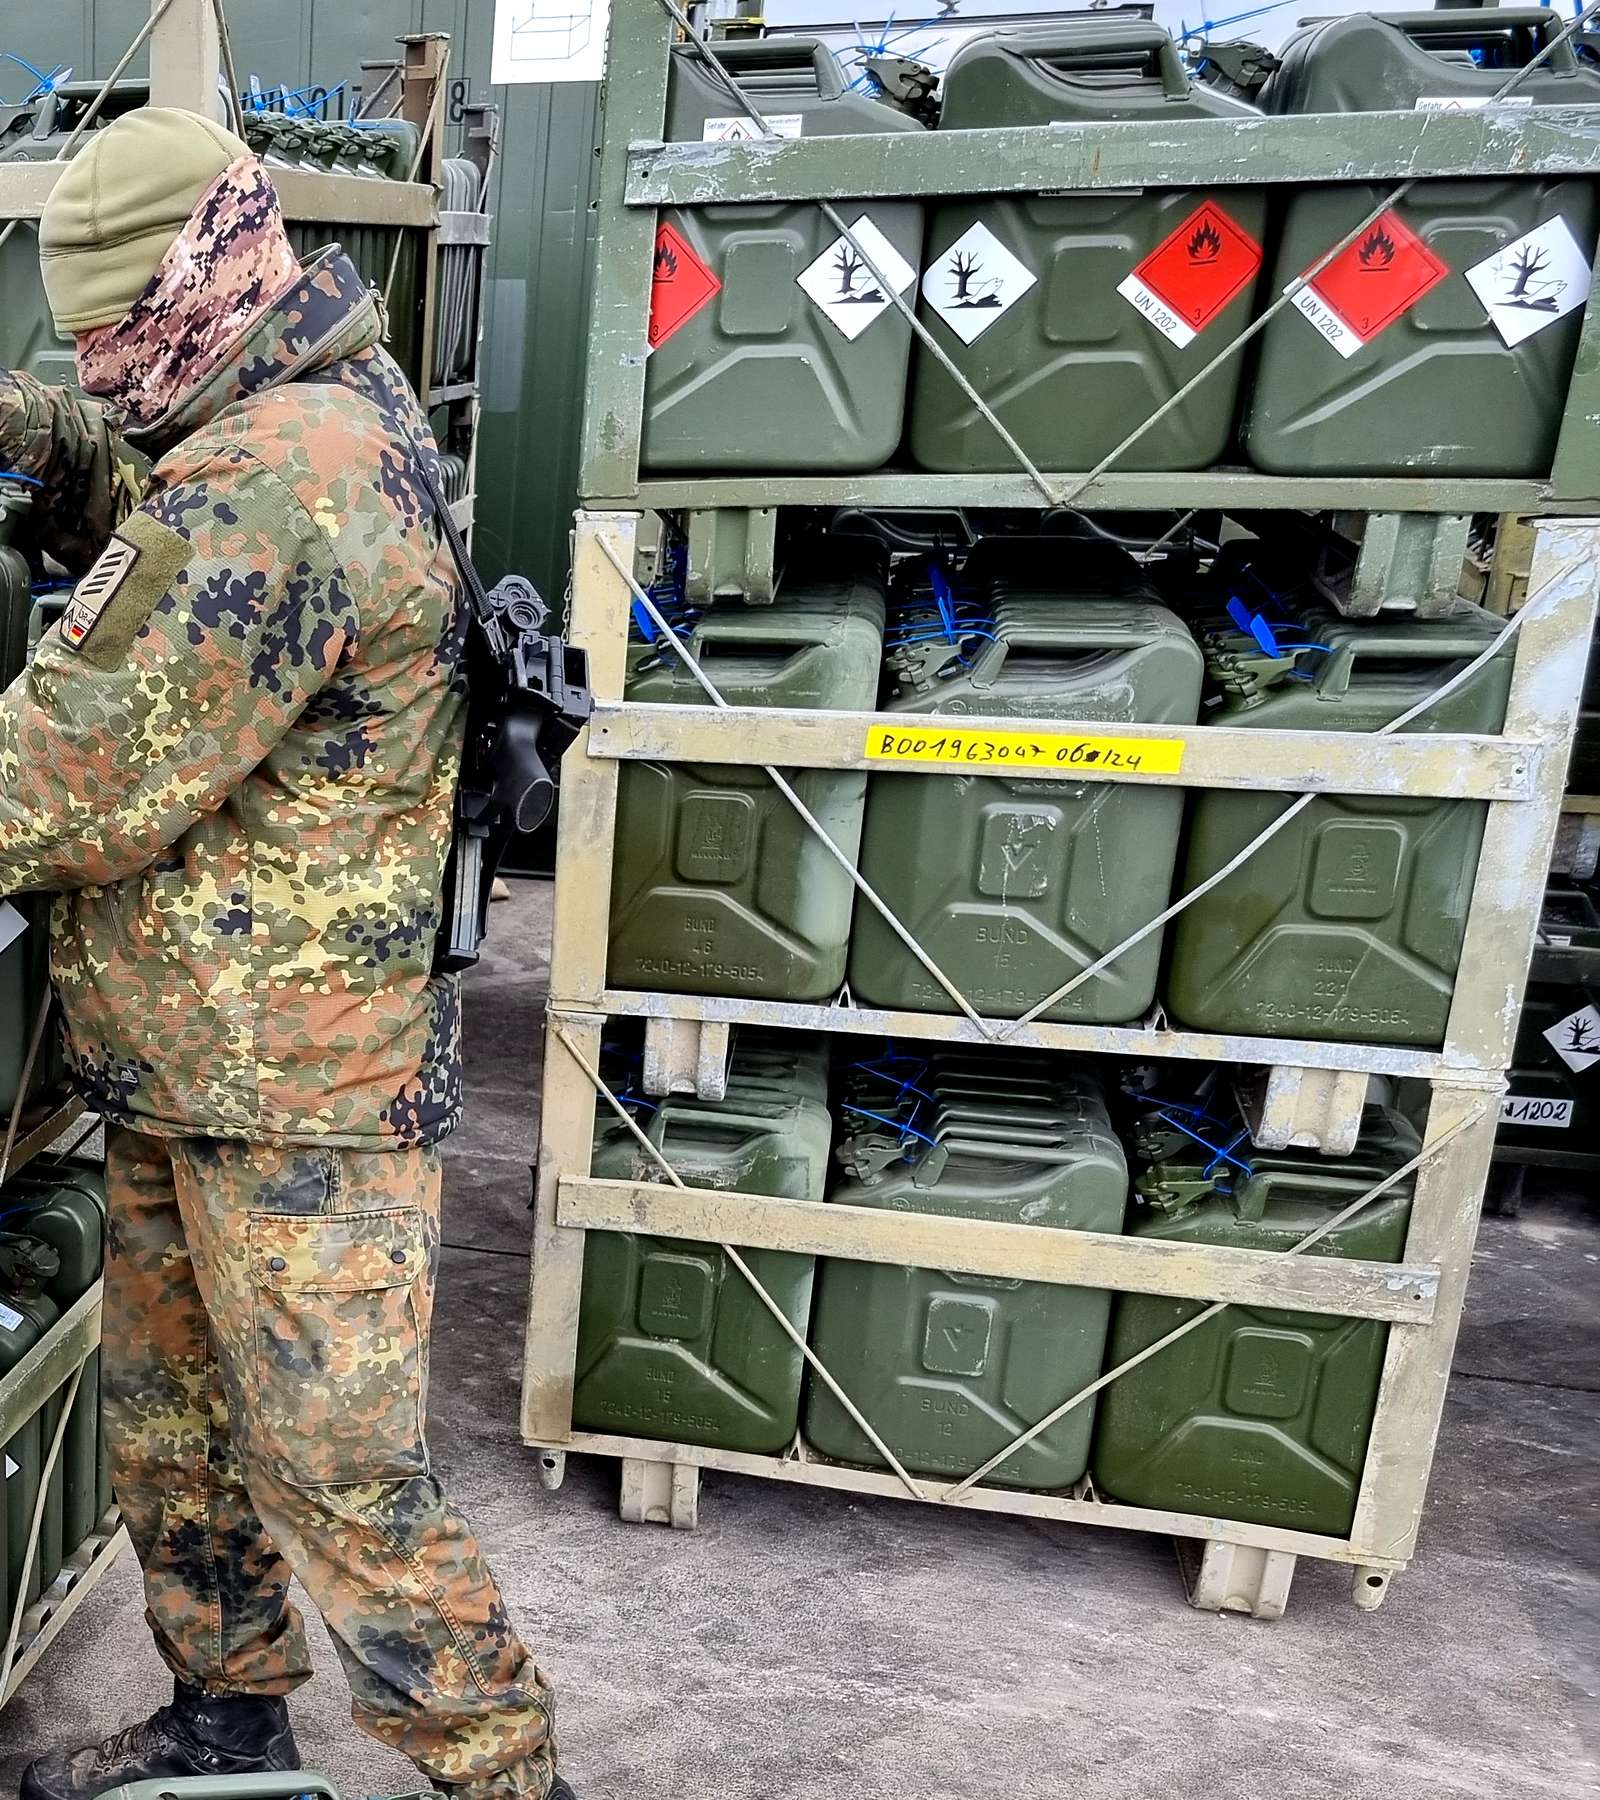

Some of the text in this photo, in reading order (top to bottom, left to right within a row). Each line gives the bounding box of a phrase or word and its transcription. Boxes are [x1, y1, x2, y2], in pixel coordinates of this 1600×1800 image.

[1133, 290, 1177, 334] UN 1202
[1193, 308, 1201, 321] 3
[1299, 295, 1344, 341] UN 1202
[651, 325, 659, 337] 3
[1361, 317, 1369, 330] 3
[683, 917, 715, 933] BUND
[975, 927, 1029, 945] BUND
[1513, 1101, 1568, 1121] 1202
[920, 1398, 969, 1417] BUND
